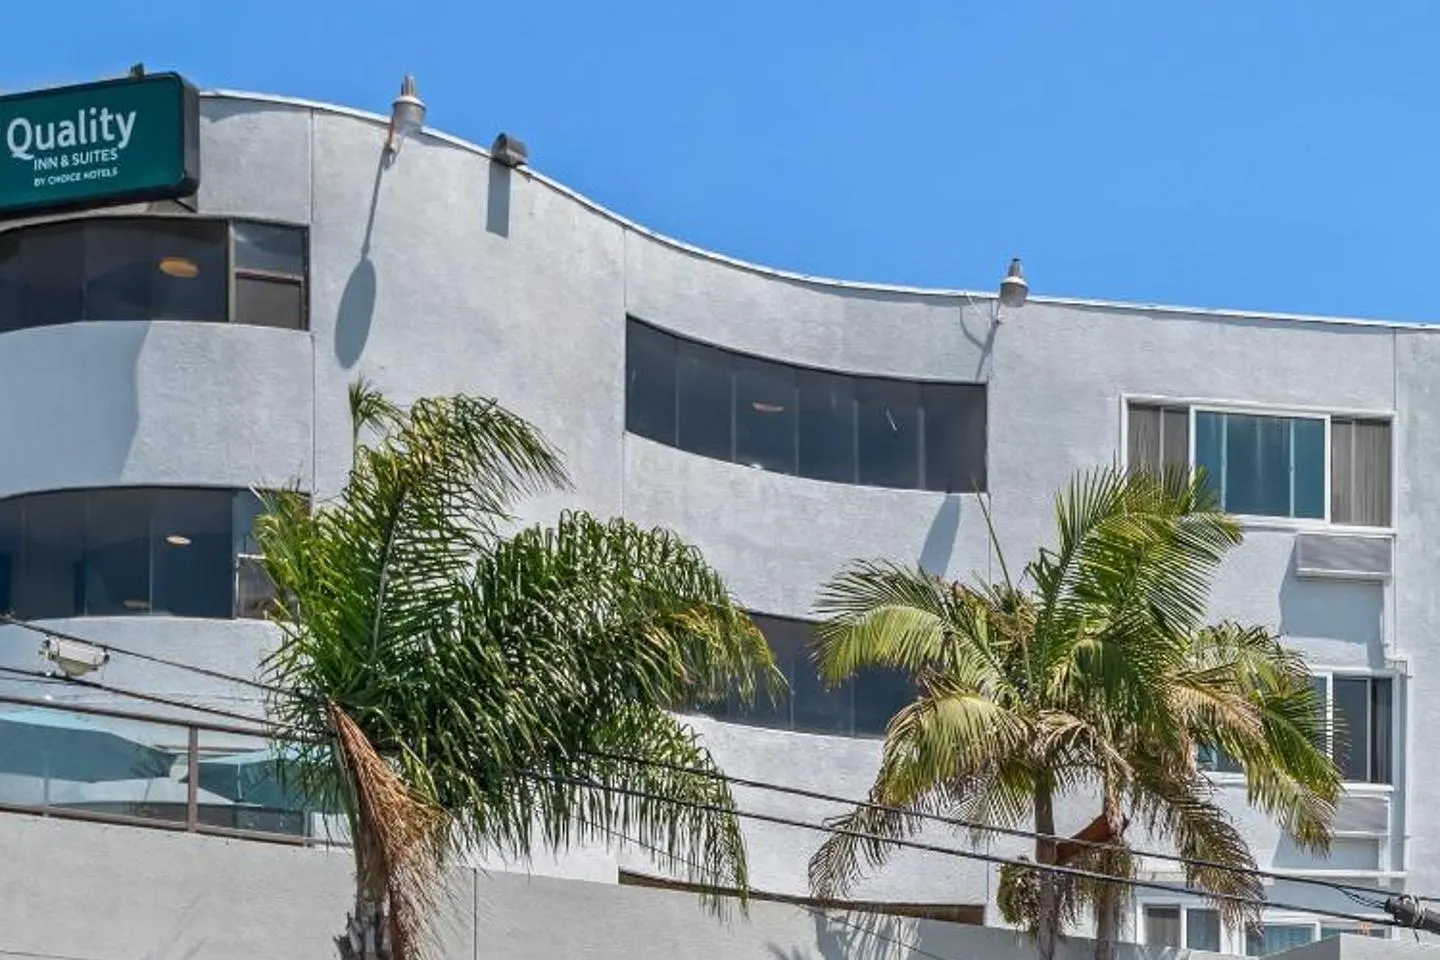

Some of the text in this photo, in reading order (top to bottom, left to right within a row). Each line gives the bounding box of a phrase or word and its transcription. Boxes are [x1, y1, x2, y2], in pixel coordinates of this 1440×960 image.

[7, 107, 137, 160] Quality
[34, 148, 118, 170] INN & SUITES
[34, 178, 45, 187] BY
[83, 167, 118, 180] HOTELS
